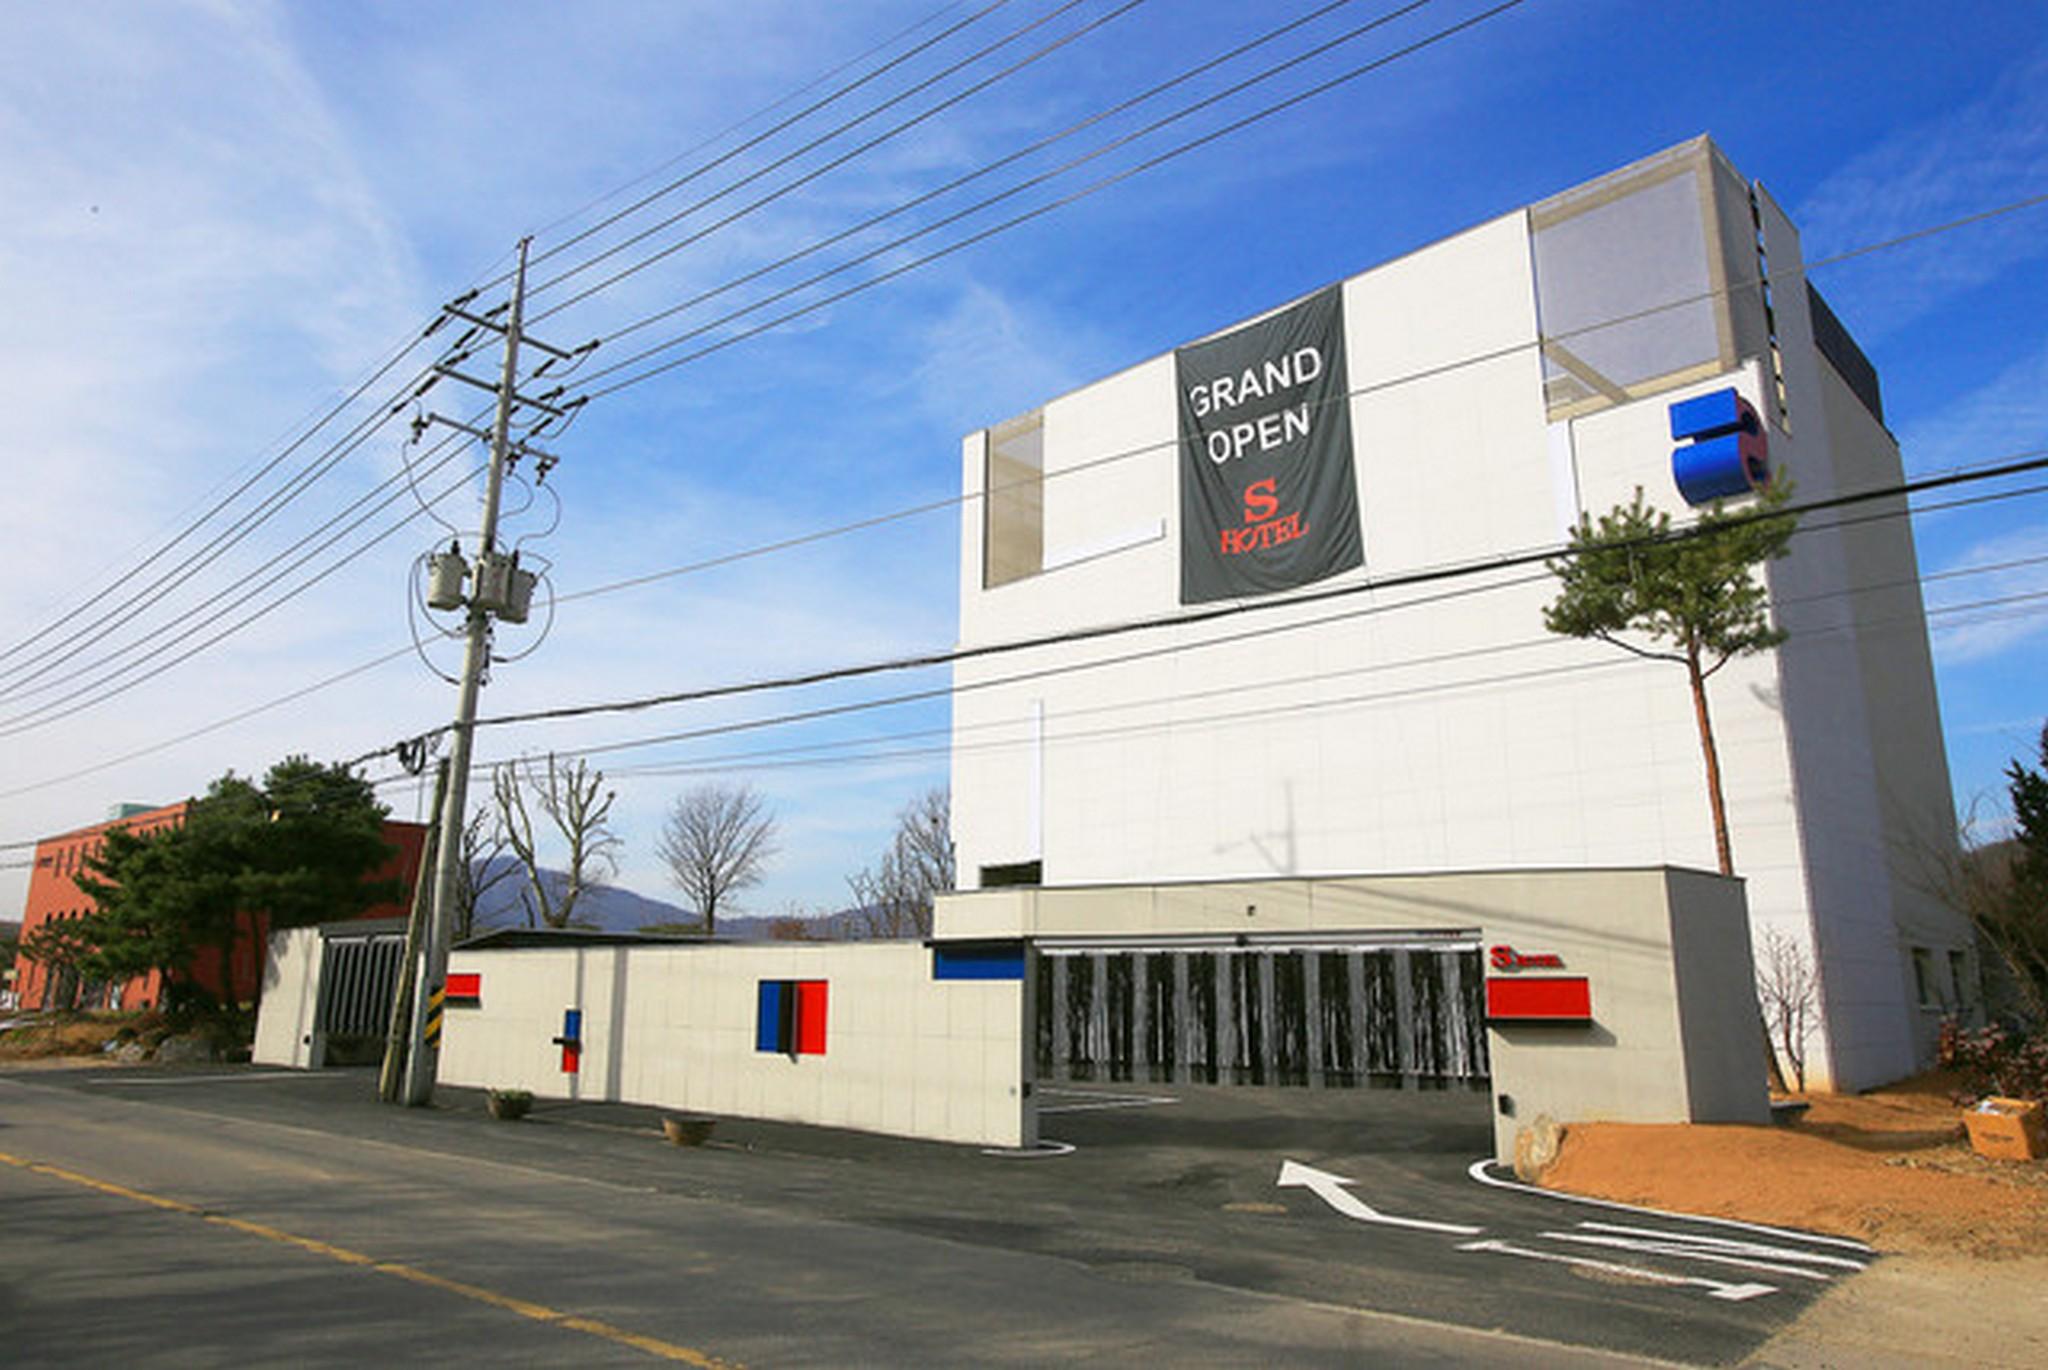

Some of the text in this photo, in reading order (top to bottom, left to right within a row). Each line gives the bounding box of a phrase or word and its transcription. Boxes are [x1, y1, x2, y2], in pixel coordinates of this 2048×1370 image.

[1190, 347, 1322, 417] GRAND
[1208, 402, 1311, 464] OPEN
[1243, 477, 1280, 524] S
[1221, 512, 1311, 555] HOTEL
